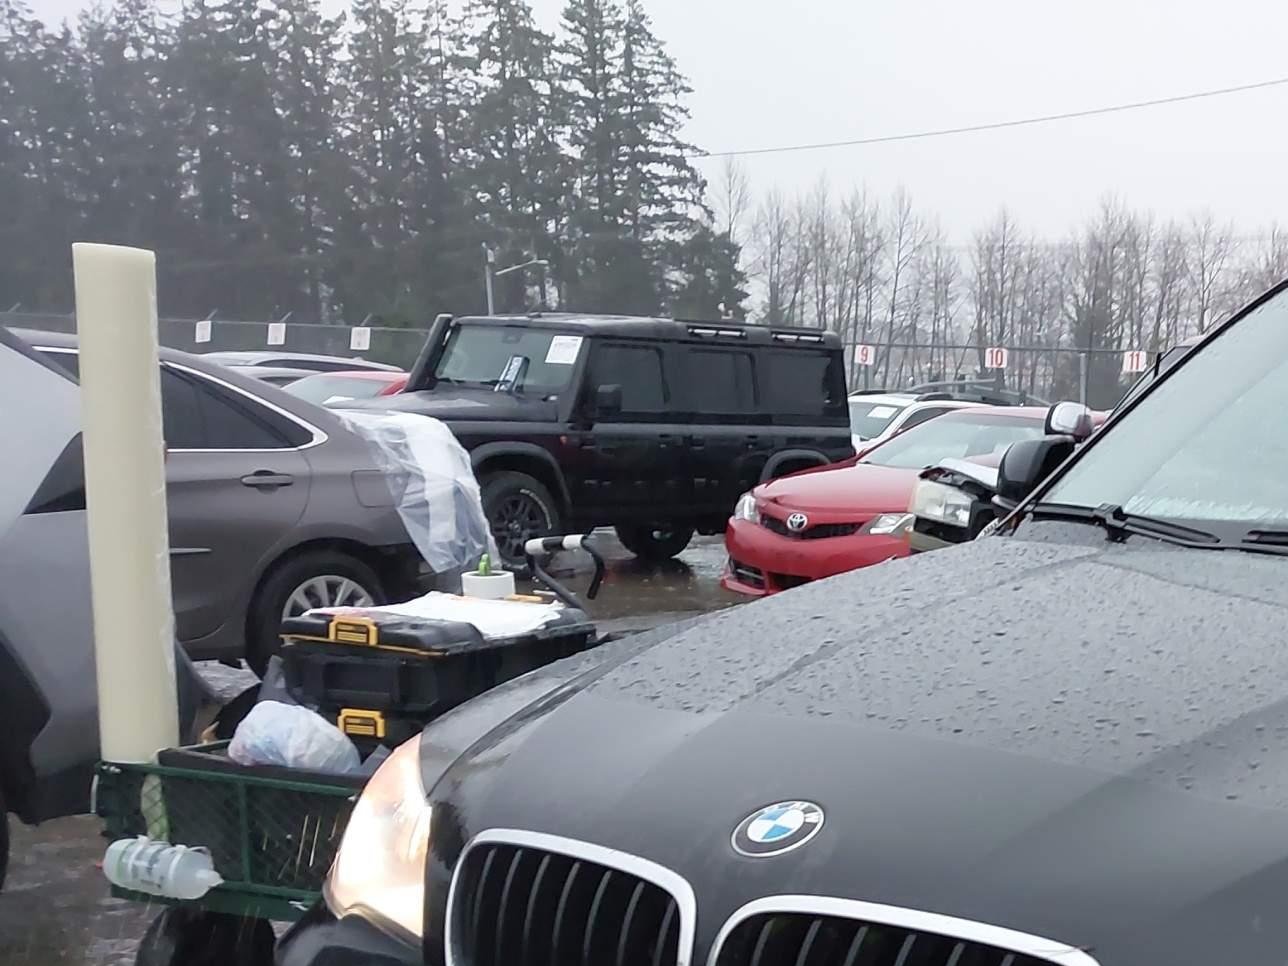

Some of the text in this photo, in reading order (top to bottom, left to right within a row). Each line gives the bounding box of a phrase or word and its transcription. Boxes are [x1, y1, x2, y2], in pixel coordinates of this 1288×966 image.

[860, 346, 869, 362] 9
[989, 349, 1004, 366] 10
[1129, 352, 1140, 370] 11
